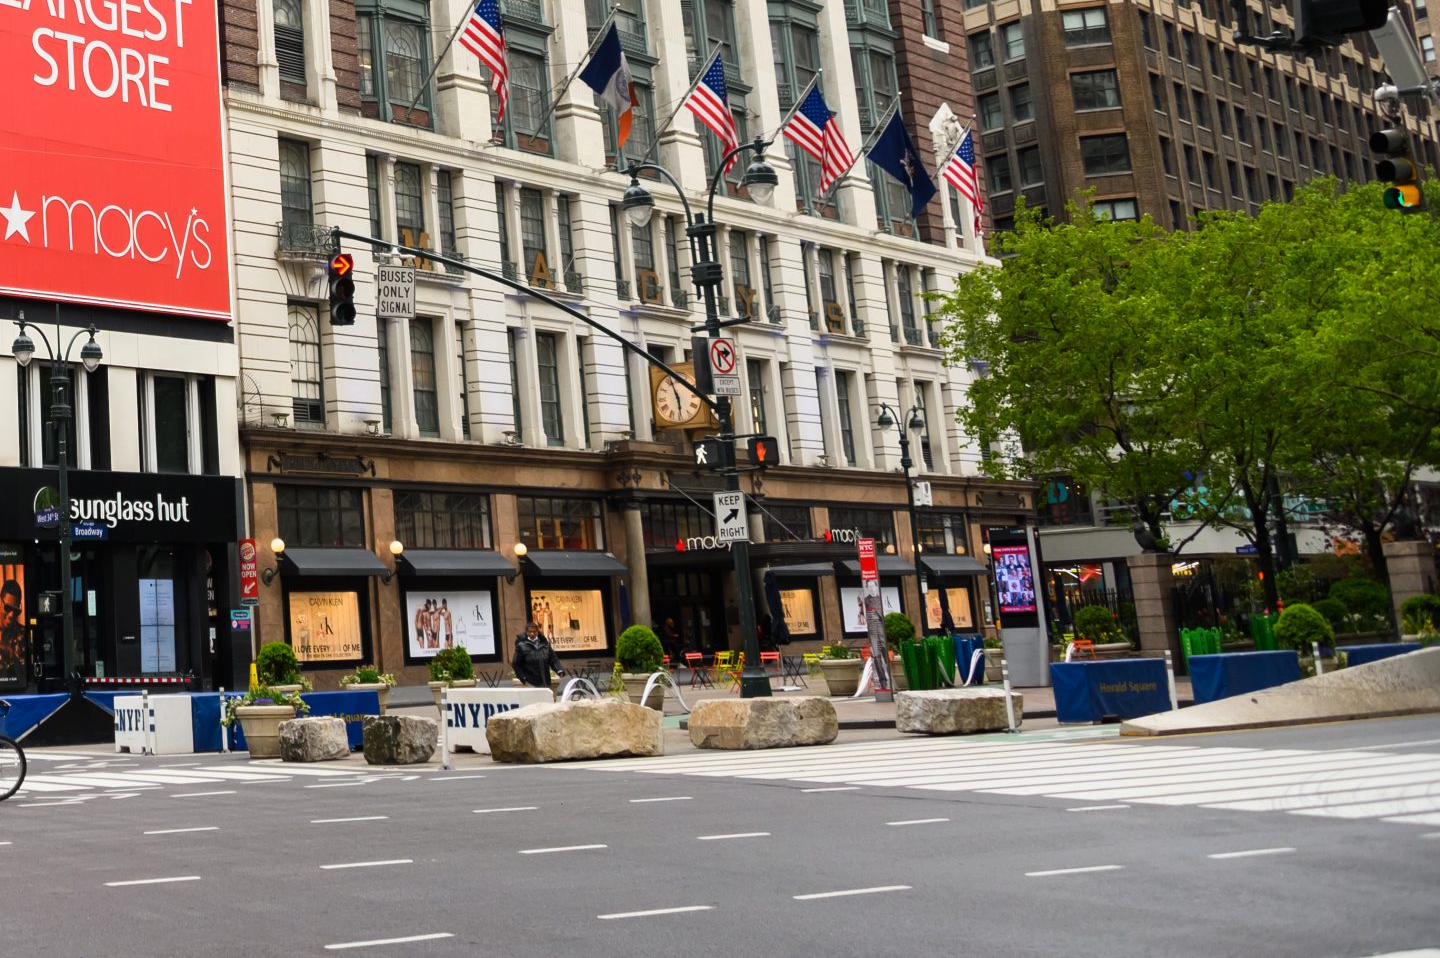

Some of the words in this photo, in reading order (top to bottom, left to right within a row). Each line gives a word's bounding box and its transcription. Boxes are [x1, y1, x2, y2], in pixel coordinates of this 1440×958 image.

[32, 27, 172, 112] STORE
[42, 195, 212, 280] macy's
[381, 270, 414, 283] BUSES
[383, 285, 410, 298] ONLY
[381, 300, 412, 314] SIGNAL
[719, 496, 740, 506] KEEP
[69, 492, 154, 528] sunglass
[157, 493, 190, 522] hut
[37, 515, 47, 523] West
[74, 527, 103, 538] Broadway
[720, 527, 745, 538] RIGHT
[242, 563, 256, 571] NOW
[119, 709, 145, 732] NYP
